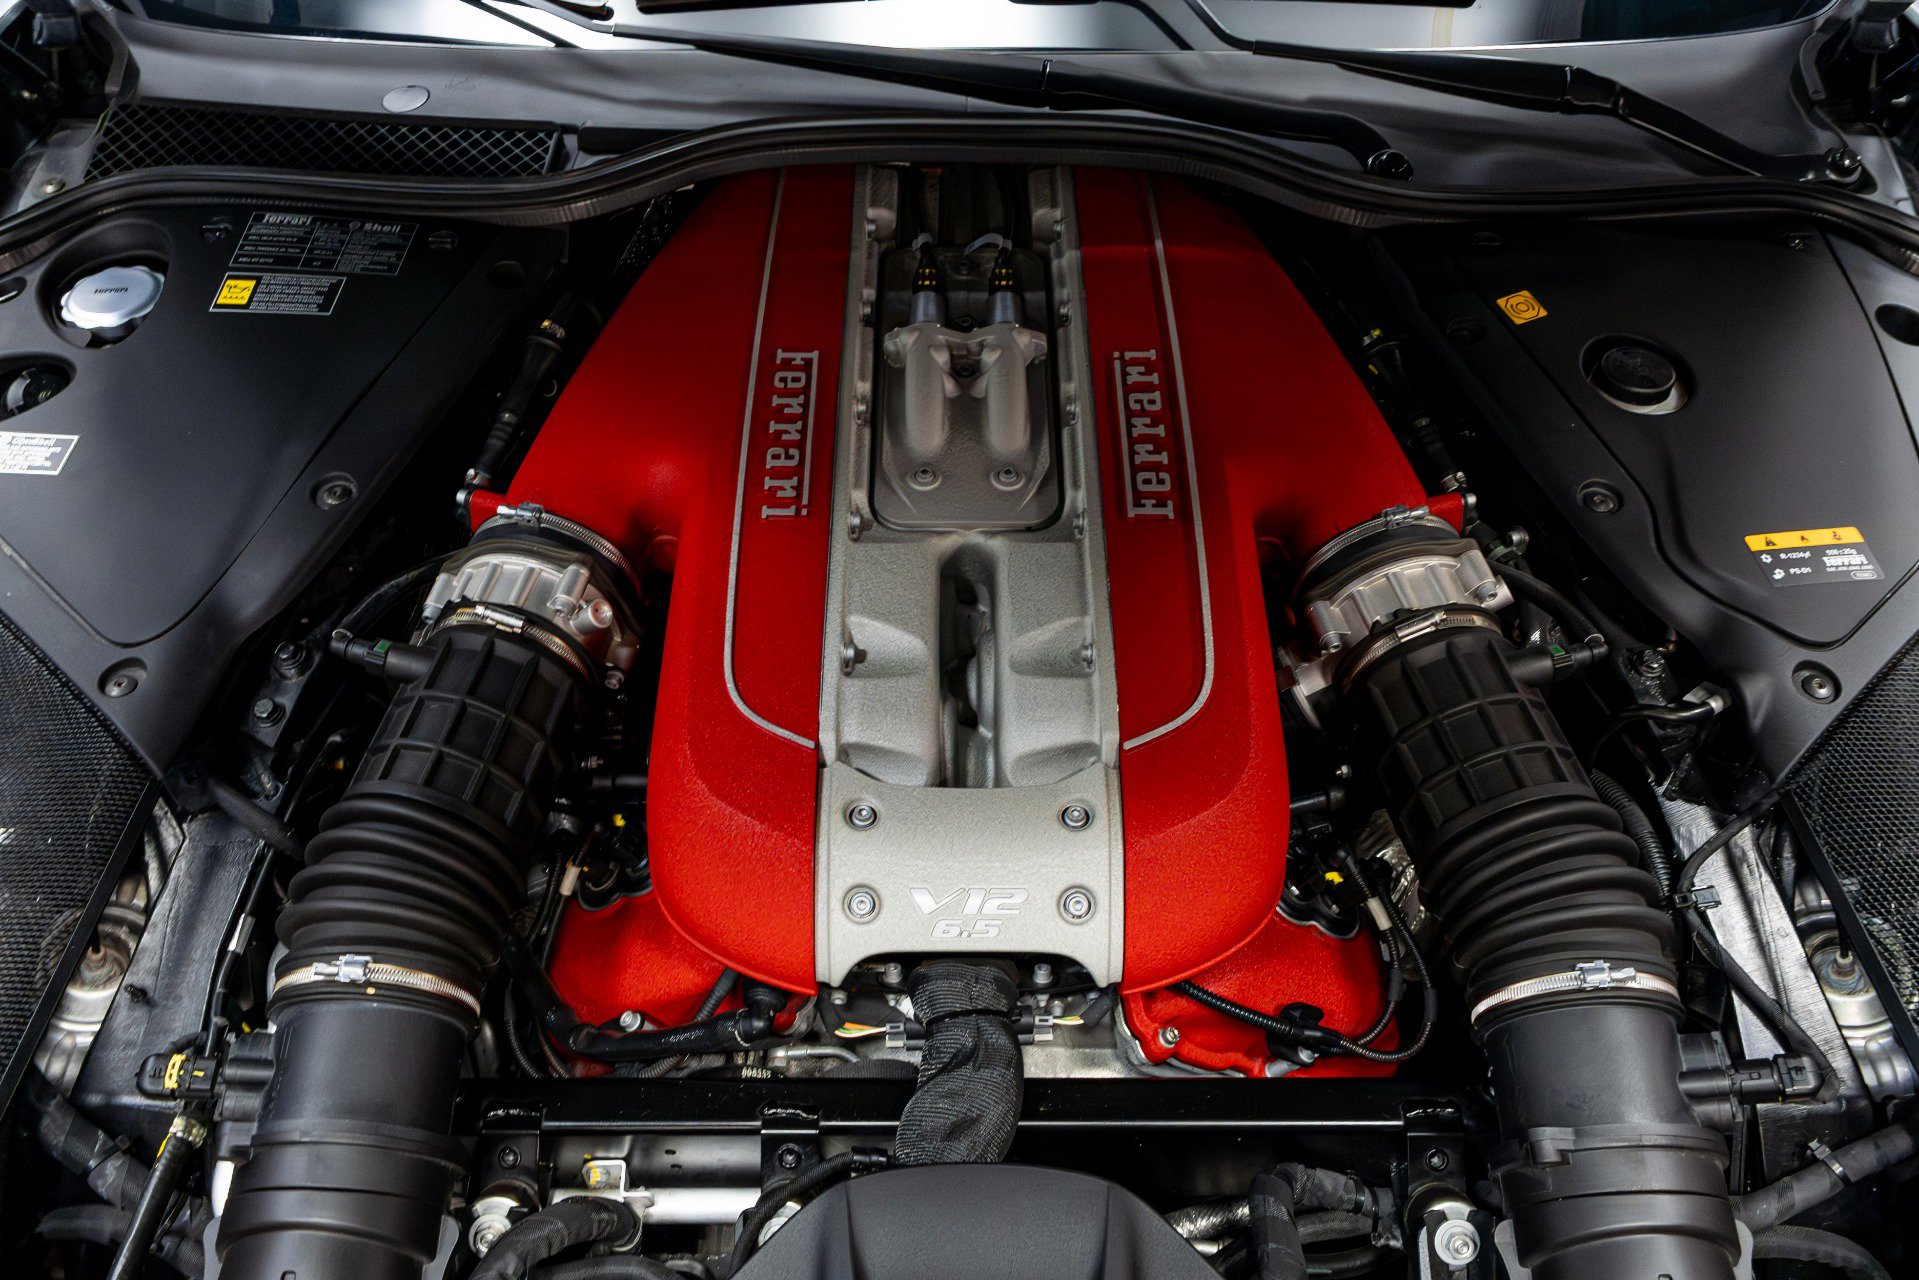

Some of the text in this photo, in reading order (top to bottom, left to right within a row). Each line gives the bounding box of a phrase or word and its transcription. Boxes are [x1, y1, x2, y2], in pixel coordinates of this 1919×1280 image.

[363, 222, 401, 233] Shell
[761, 348, 820, 519] Ferrari
[1113, 349, 1175, 520] Ferrari
[909, 887, 1029, 915] V12
[931, 919, 1004, 938] 6.5
